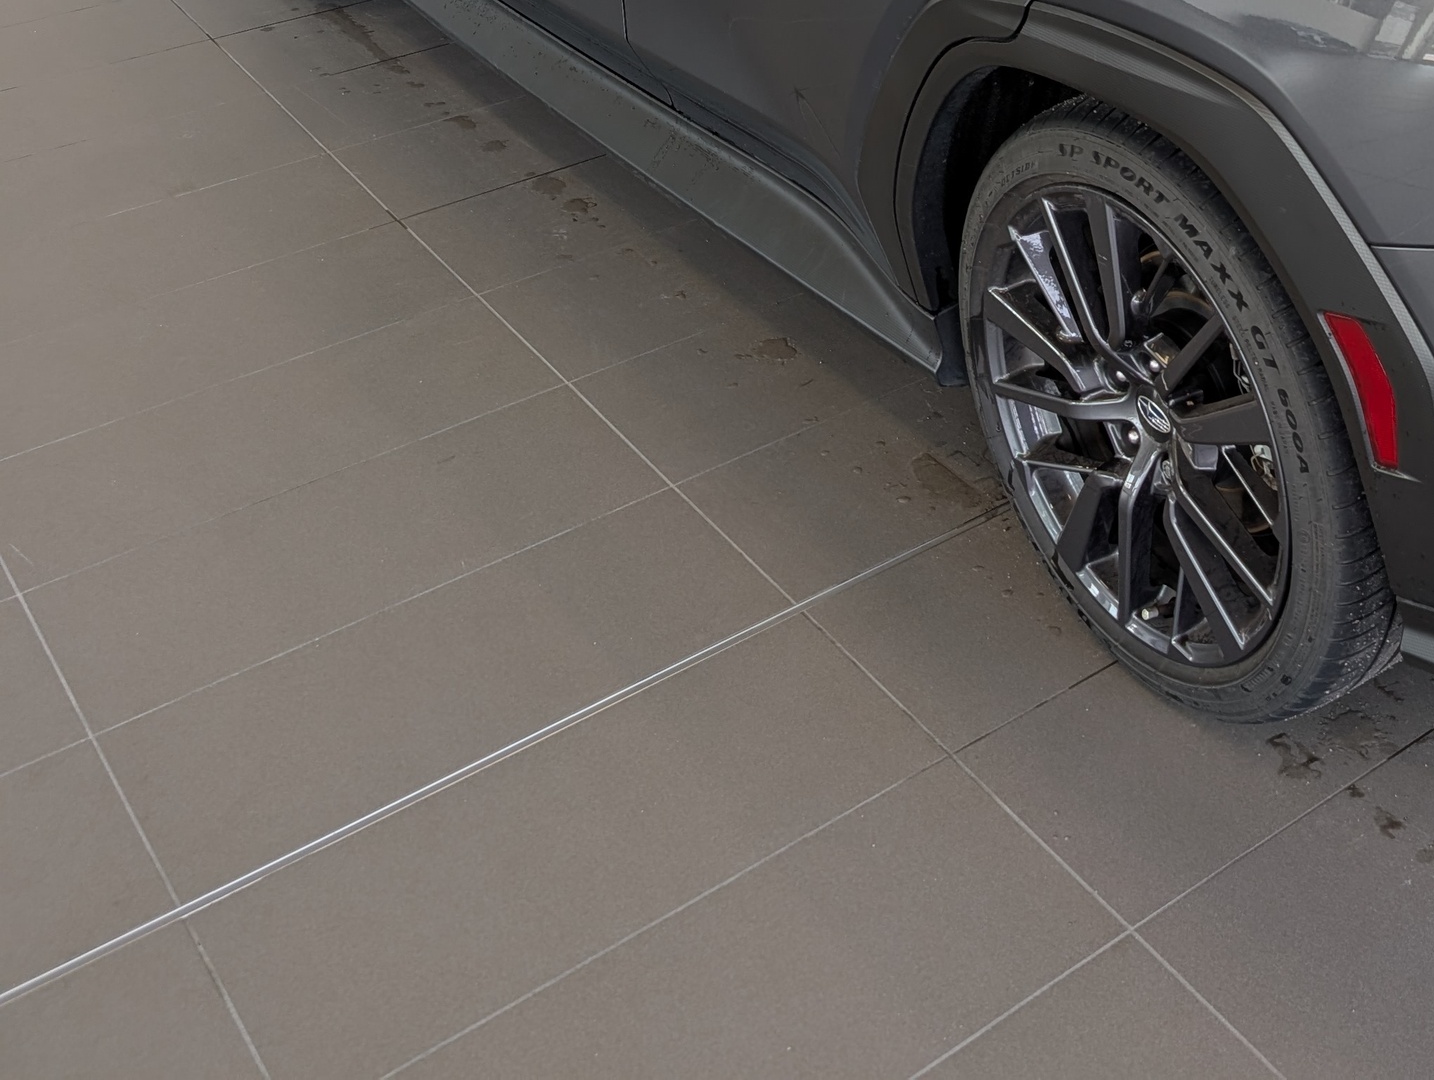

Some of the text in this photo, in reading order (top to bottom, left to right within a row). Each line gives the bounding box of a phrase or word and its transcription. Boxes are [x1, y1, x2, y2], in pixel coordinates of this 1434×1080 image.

[1058, 143, 1310, 474] SP SPORT MAXX GT 600A
